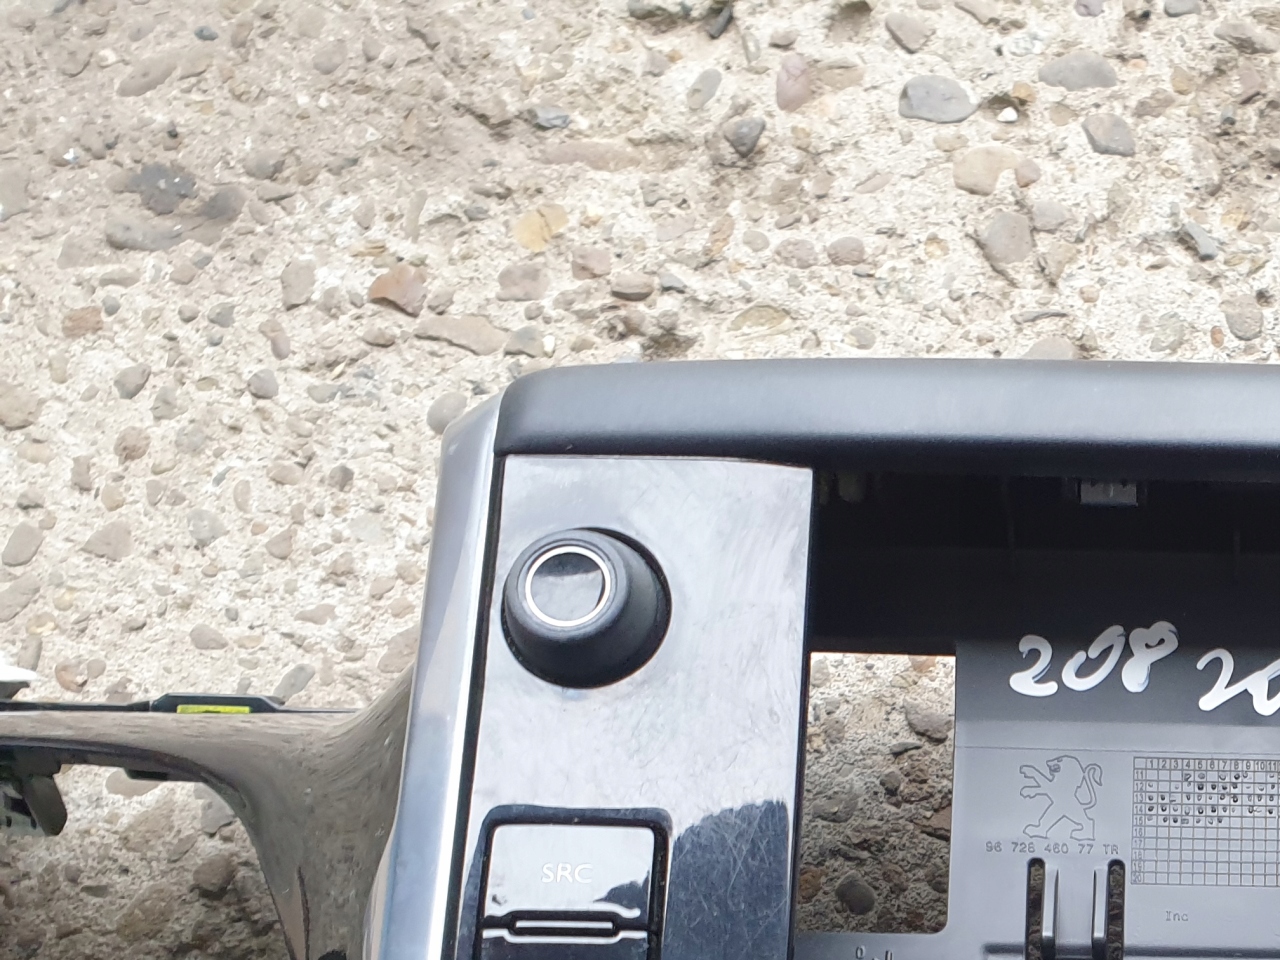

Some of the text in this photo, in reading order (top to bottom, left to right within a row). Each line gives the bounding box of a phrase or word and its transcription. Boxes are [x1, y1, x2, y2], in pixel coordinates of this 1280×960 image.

[1009, 621, 1179, 696] 208
[1078, 843, 1094, 854] 77
[541, 863, 593, 883] SRC
